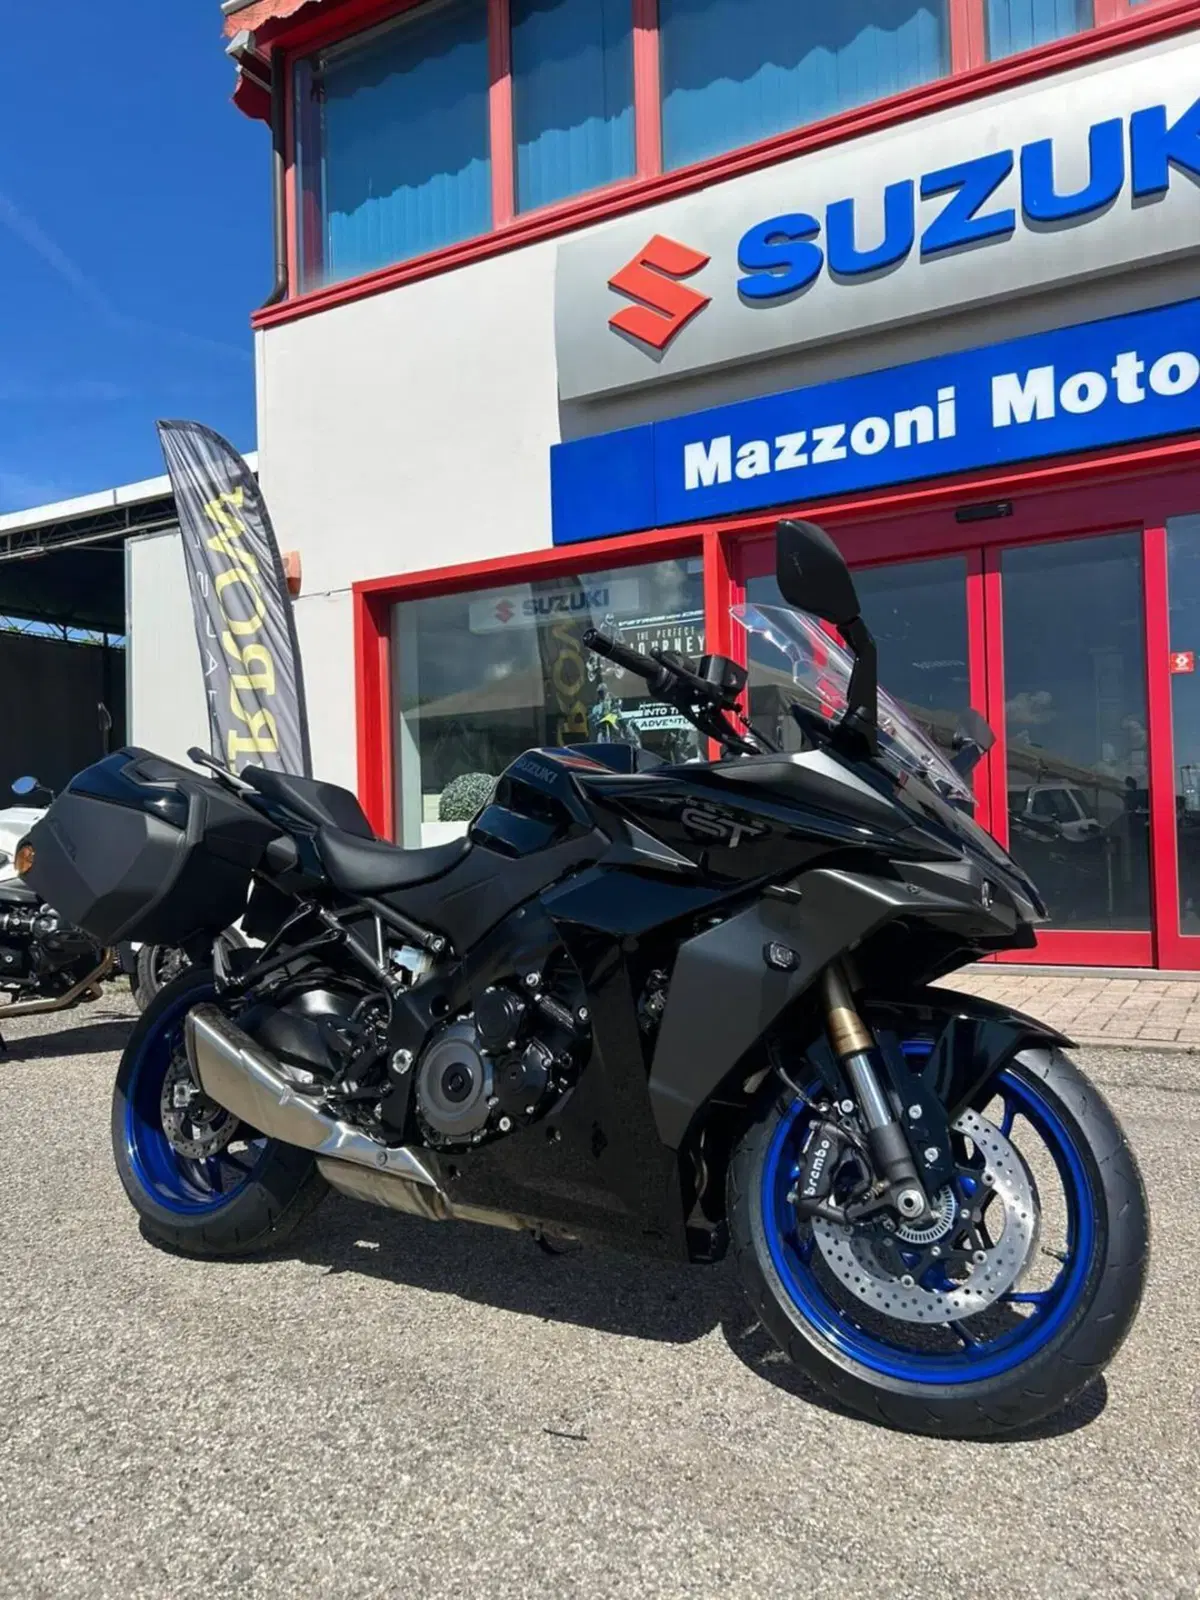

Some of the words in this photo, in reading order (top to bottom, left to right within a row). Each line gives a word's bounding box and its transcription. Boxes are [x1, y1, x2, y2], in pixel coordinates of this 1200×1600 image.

[737, 96, 1200, 300] SUZUK
[683, 386, 956, 491] Mazzoni
[991, 350, 1200, 428] Moto
[522, 588, 609, 616] SUZUKI
[656, 626, 695, 638] PERFECT
[644, 707, 668, 716] INTO
[513, 756, 559, 784] SUZUKI
[803, 1139, 831, 1196] brembo
